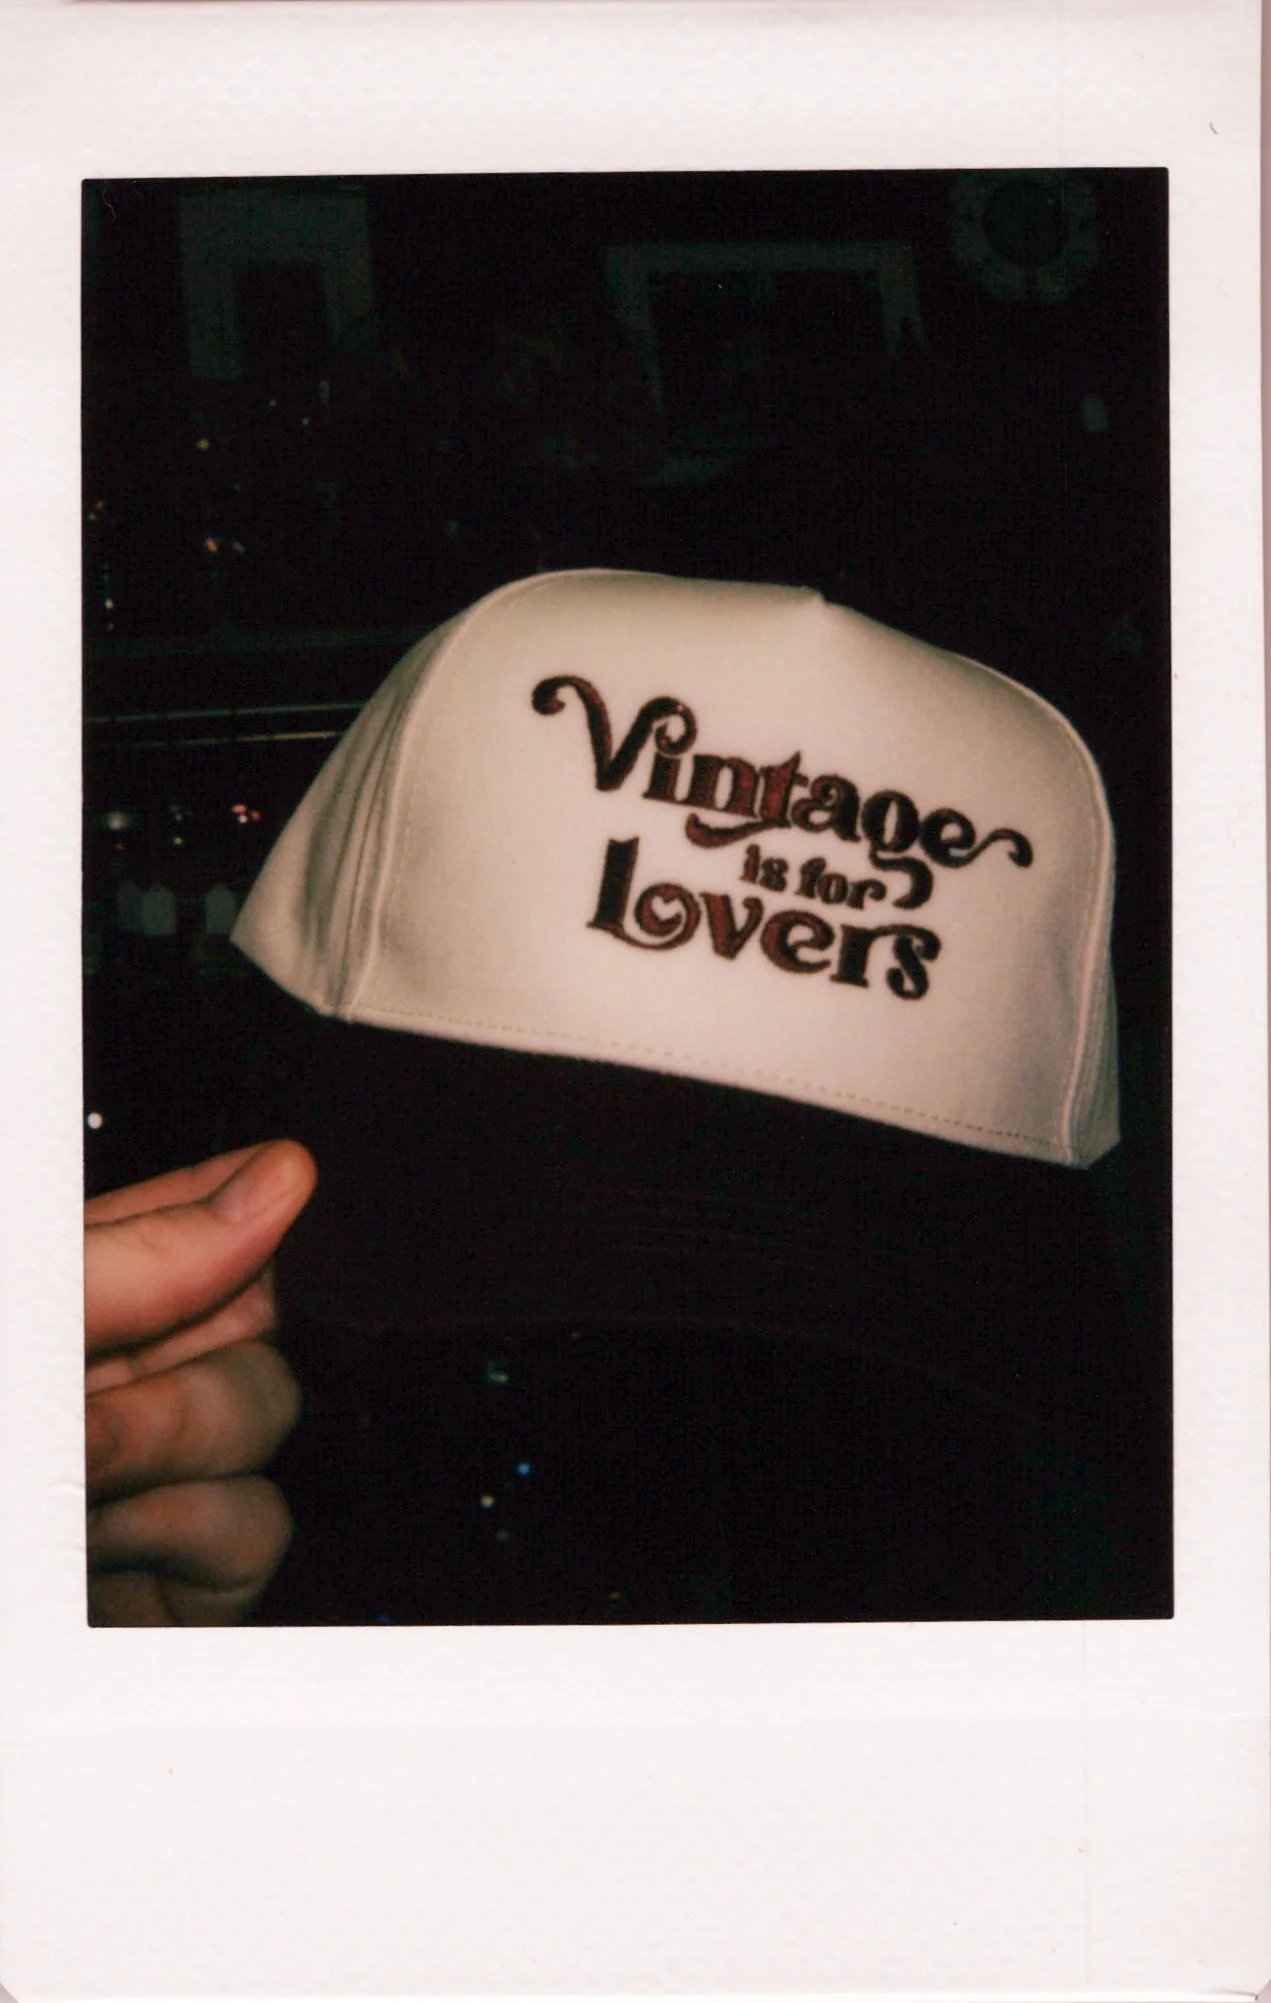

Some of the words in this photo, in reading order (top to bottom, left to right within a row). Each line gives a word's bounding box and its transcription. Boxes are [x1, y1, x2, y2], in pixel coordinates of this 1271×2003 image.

[531, 674, 1033, 910] Vintage
[586, 836, 942, 1001] Lovers
[740, 843, 789, 892] is
[795, 856, 888, 911] for
